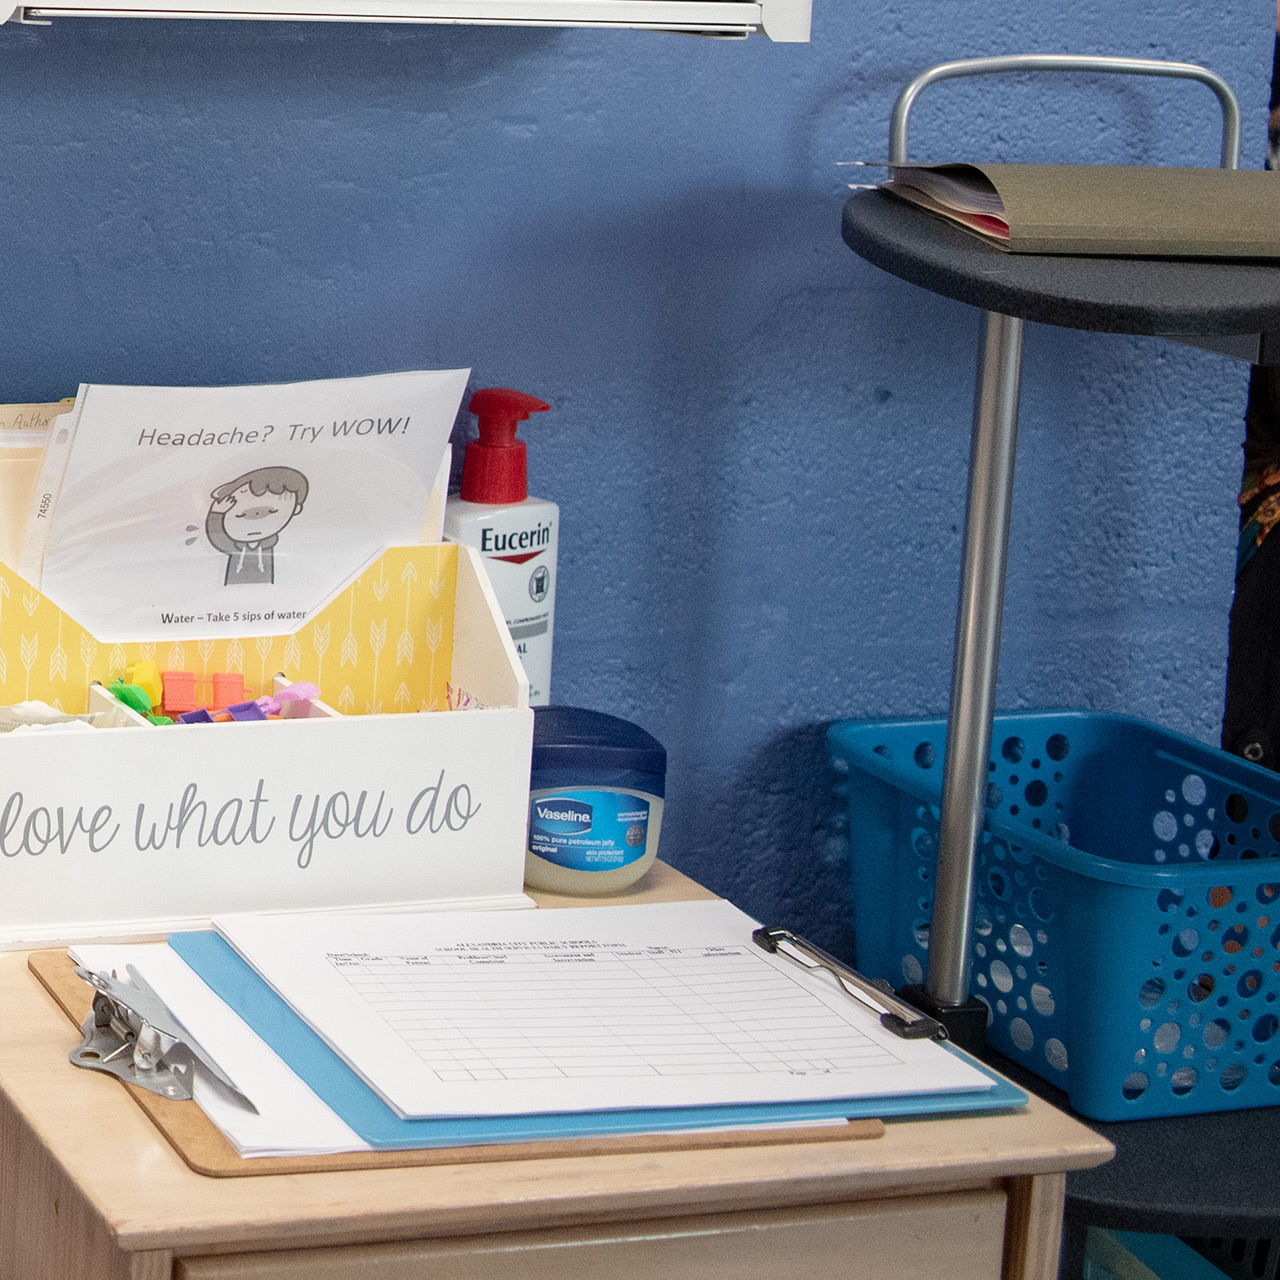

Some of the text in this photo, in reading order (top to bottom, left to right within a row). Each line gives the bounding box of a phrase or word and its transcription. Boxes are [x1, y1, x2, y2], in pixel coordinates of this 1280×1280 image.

[138, 416, 410, 446] Headache? Try WOW!
[37, 493, 52, 519] 74550
[481, 522, 550, 552] Eucerin
[161, 613, 194, 623] Water
[207, 613, 230, 622] Take
[234, 612, 239, 621] 5
[242, 611, 261, 622] sips
[264, 610, 275, 620] of
[277, 611, 306, 619] water
[0, 768, 482, 869] love what you do
[532, 845, 557, 853] original
[569, 838, 601, 847] petroleum
